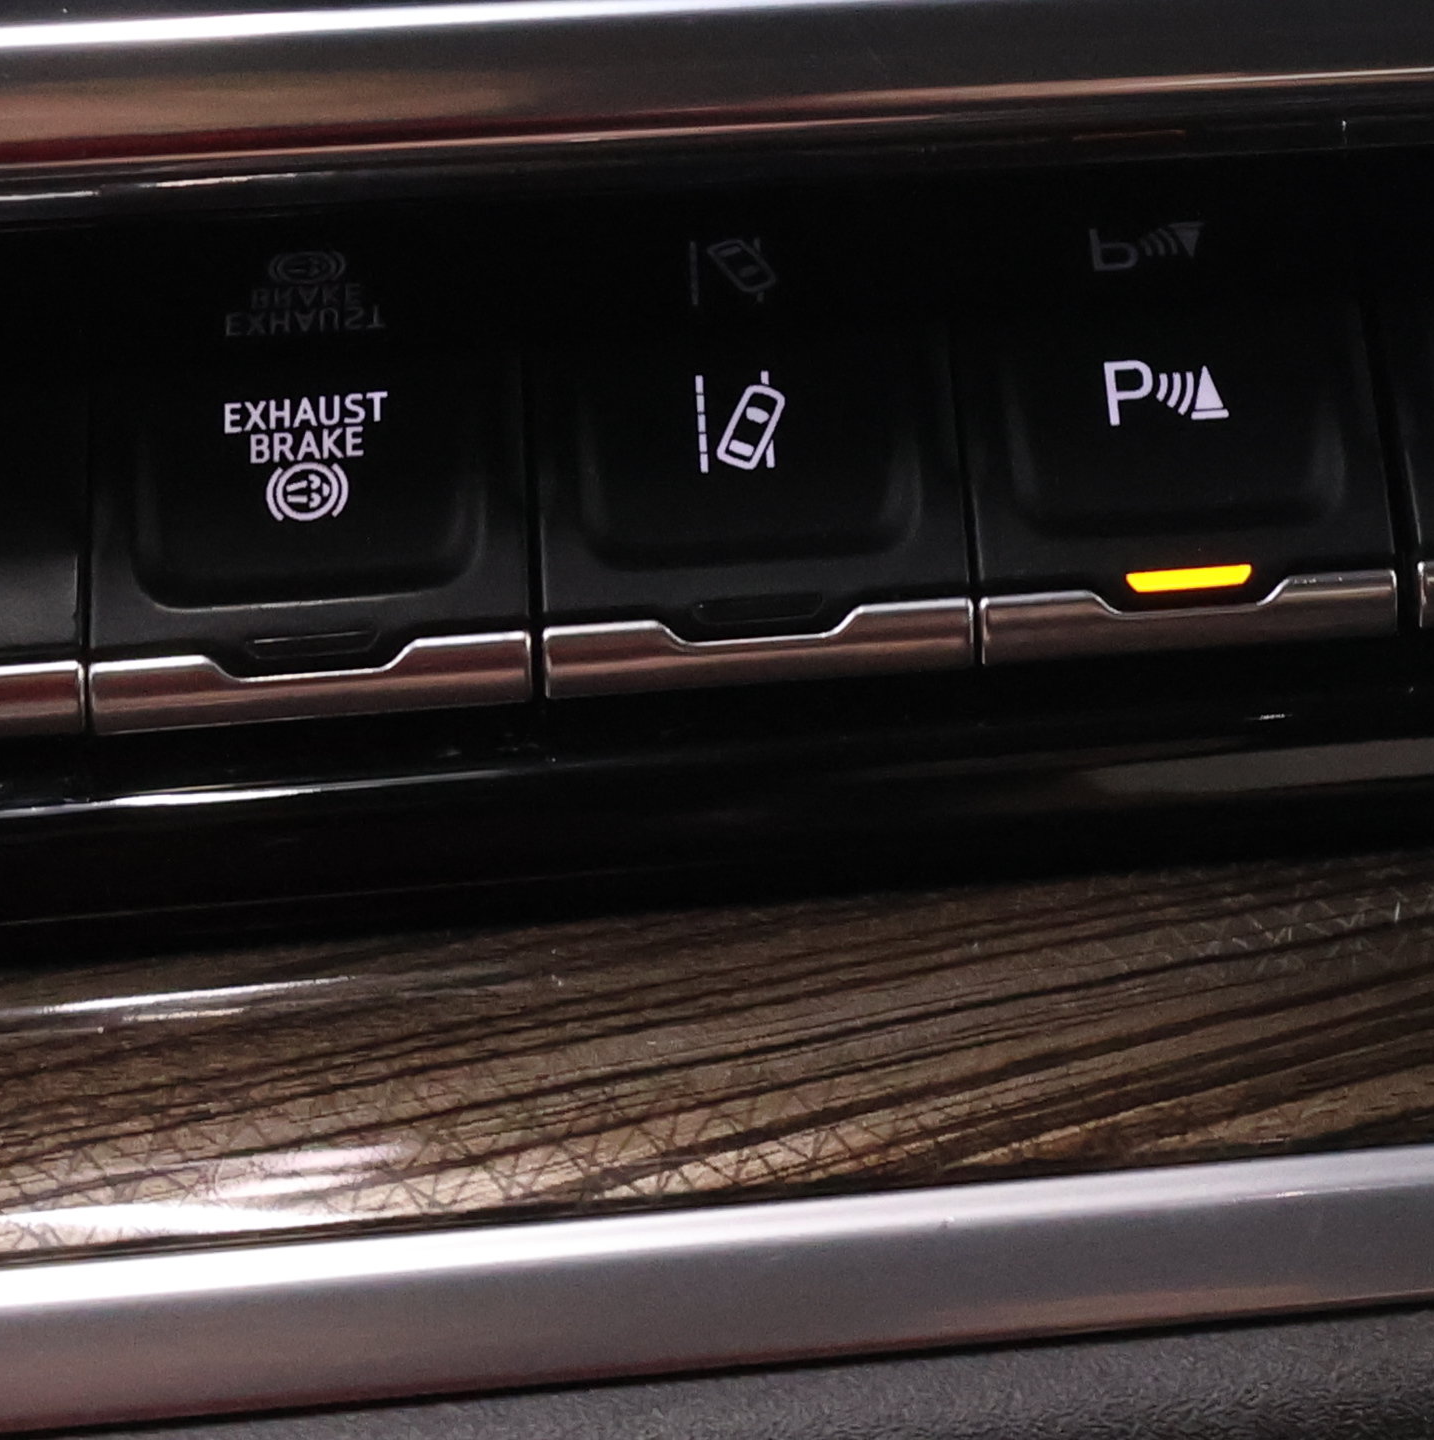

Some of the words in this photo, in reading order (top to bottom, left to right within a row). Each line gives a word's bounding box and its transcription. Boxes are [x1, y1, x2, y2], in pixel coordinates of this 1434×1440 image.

[223, 391, 388, 434] EXHAUST
[1103, 360, 1154, 427] P
[249, 425, 365, 464] BRAKE
